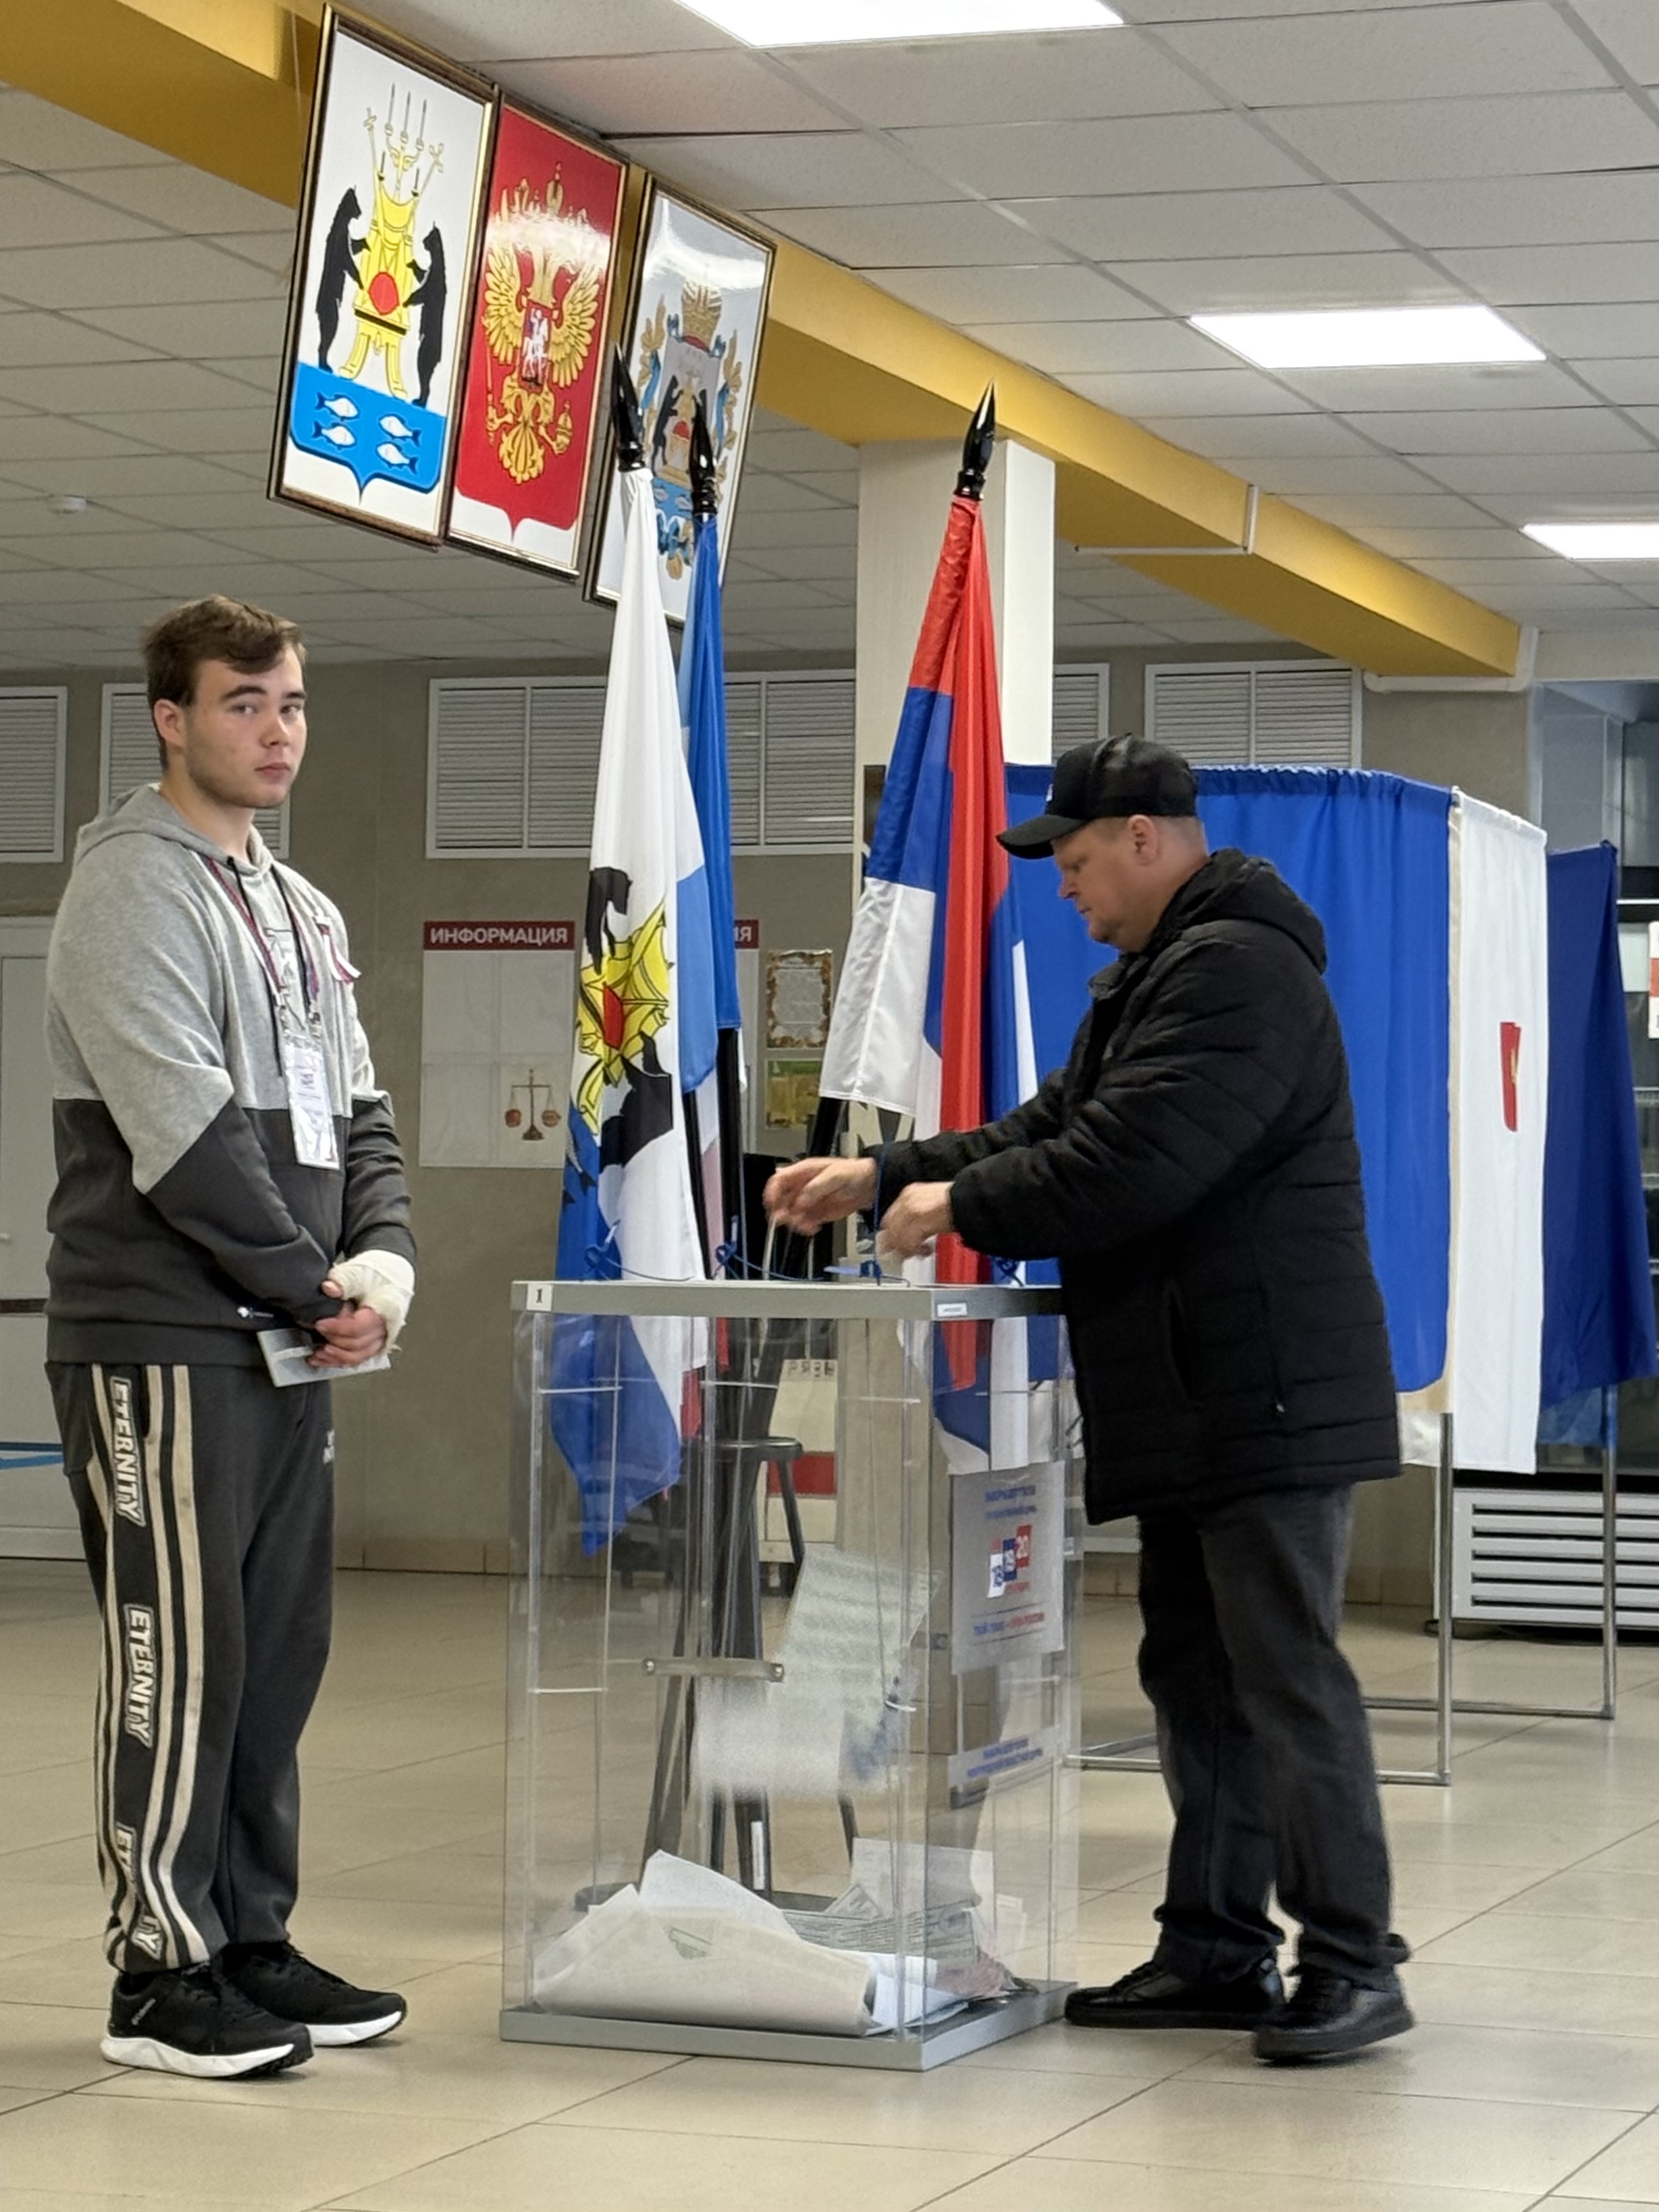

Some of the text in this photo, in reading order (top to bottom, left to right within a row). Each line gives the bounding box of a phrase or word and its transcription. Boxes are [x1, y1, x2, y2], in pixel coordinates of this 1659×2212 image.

[430, 927, 568, 946] ИНФОРМАЦИЯ
[536, 1288, 543, 1304] 1
[113, 1381, 141, 1519] ETERNITY
[128, 1608, 154, 1739] ETERNITY
